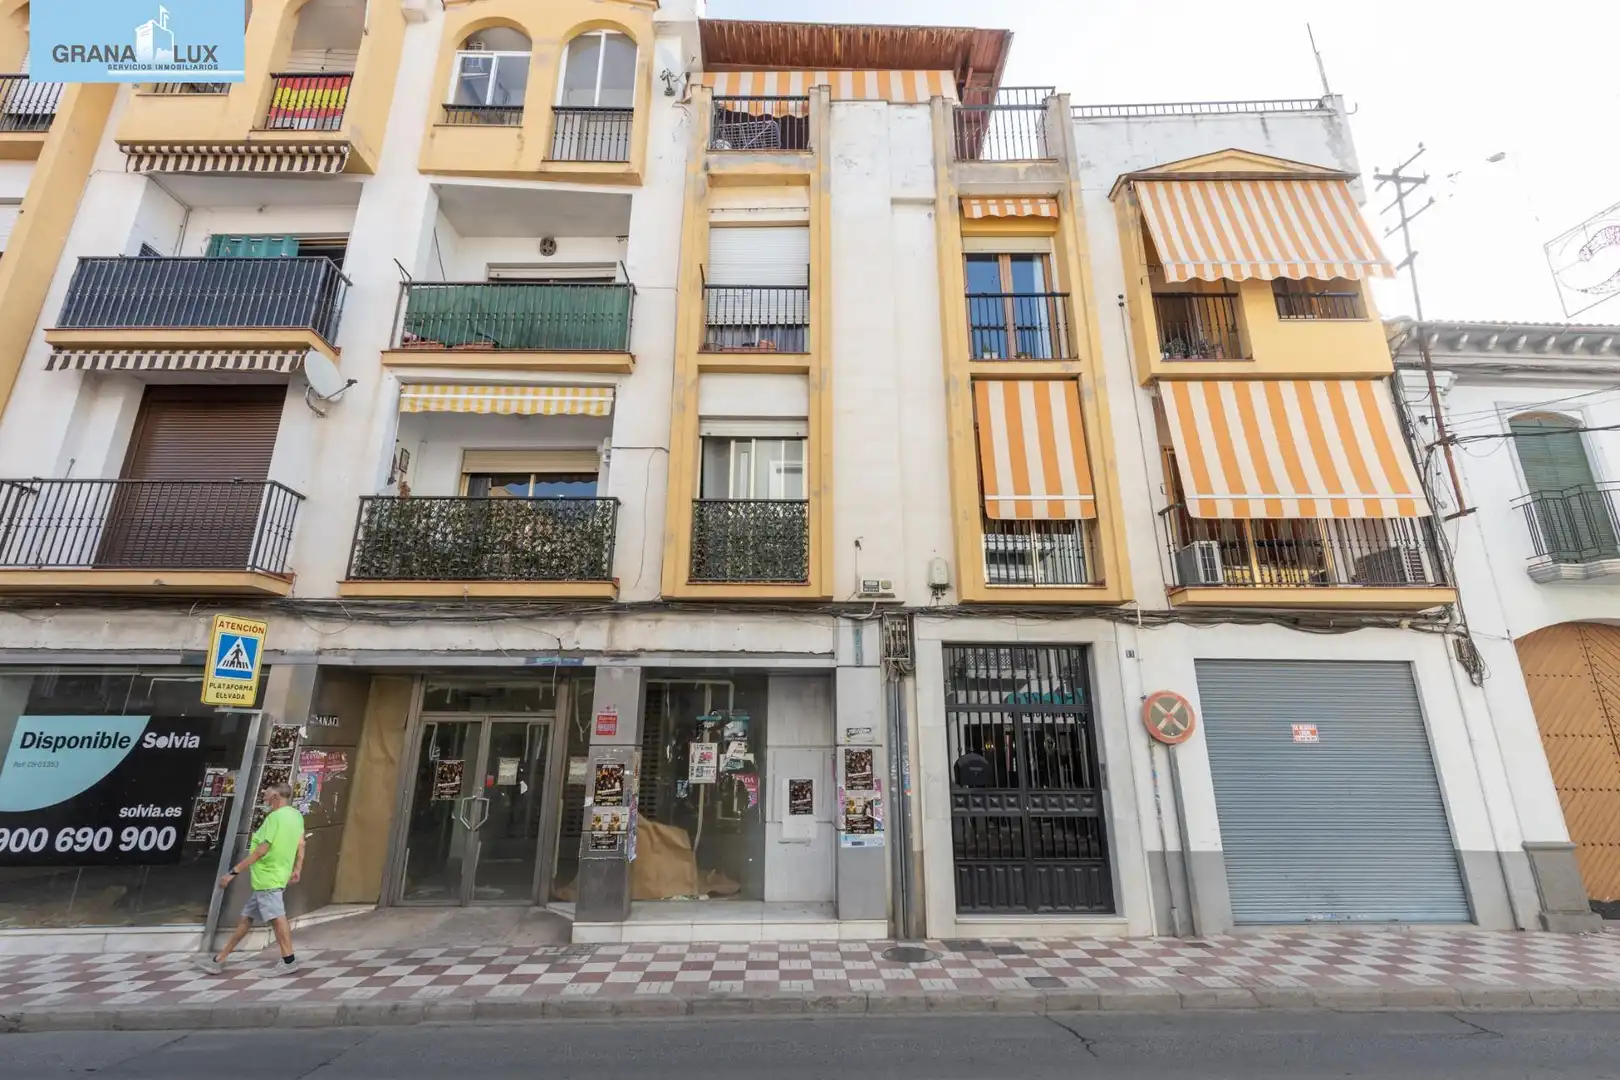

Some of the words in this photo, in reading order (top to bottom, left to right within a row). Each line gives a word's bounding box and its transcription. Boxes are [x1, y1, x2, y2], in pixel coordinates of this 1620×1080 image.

[209, 681, 254, 692] PLATAFORMA
[215, 692, 246, 701] ELEVADA
[20, 731, 131, 753] Disponible
[142, 732, 200, 749] Solvia
[119, 804, 182, 818] solvia.es
[55, 827, 113, 853] 690
[119, 826, 177, 852] 900
